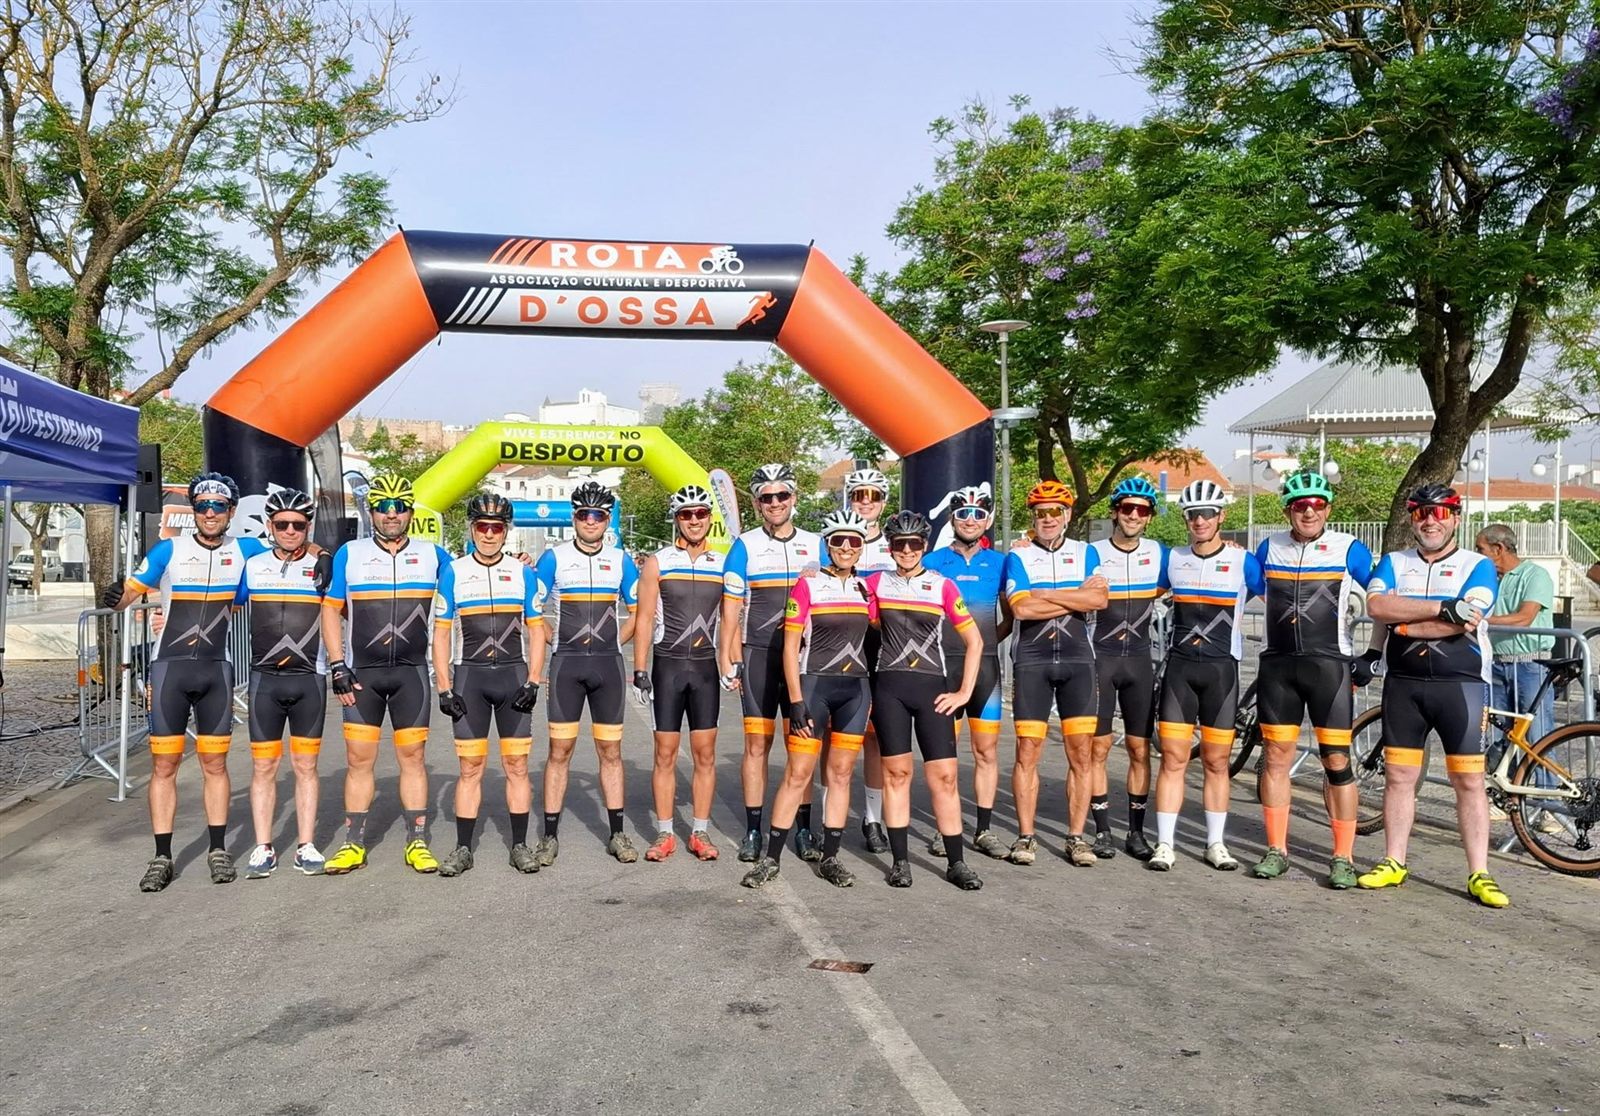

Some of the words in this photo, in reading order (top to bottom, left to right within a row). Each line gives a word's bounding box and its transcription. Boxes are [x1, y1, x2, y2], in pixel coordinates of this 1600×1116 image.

[550, 243, 686, 269] ROTA
[489, 274, 579, 288] ASSOCIAÇÃO
[583, 277, 649, 288] CULTURAL
[653, 279, 661, 288] E
[665, 279, 747, 289] DESPORTIVA
[503, 427, 536, 439] VIVE
[539, 429, 616, 440] ESTREMOZ
[619, 430, 642, 440] NO
[500, 441, 645, 463] DESPORTO
